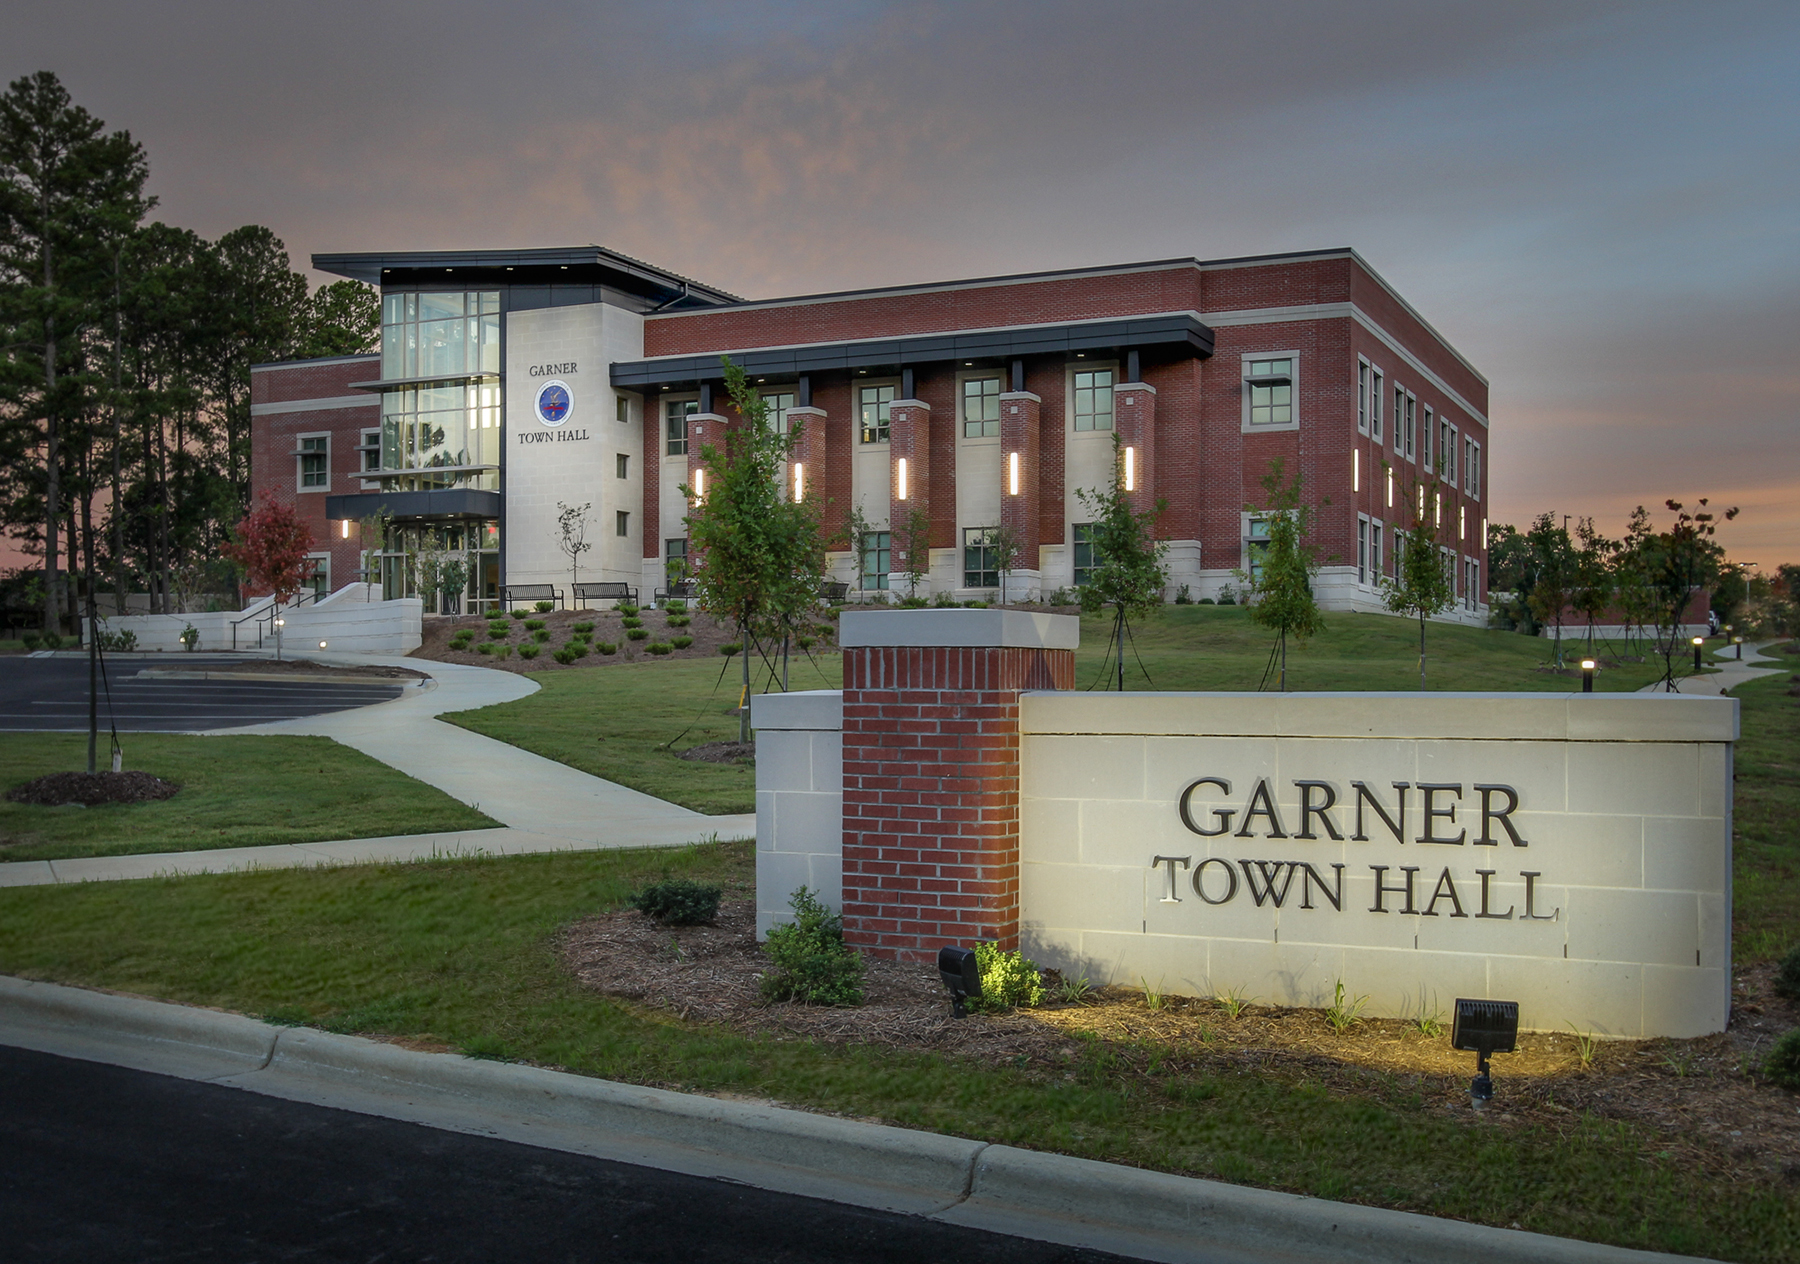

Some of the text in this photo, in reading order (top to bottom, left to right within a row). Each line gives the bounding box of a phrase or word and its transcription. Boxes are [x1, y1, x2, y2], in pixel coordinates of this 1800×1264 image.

[529, 362, 578, 377] GARNER
[518, 429, 590, 444] TOWN HALL
[1178, 776, 1529, 847] GARNER
[1152, 855, 1560, 922] TOWN HALL
